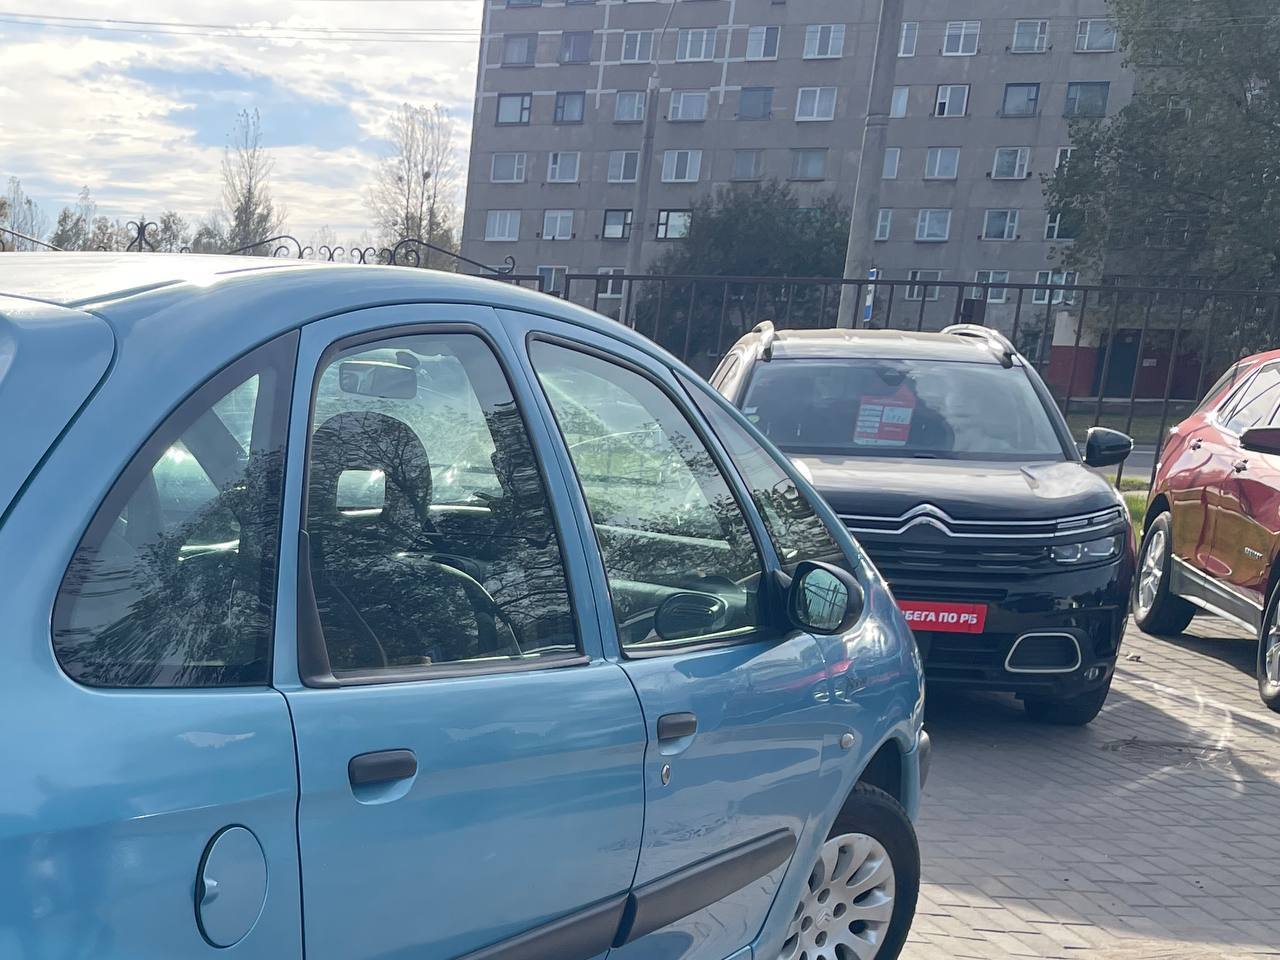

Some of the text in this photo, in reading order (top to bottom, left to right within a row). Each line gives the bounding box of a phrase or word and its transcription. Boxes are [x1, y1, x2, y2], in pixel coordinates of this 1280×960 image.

[902, 610, 978, 625] БЕГА ПО РБ
